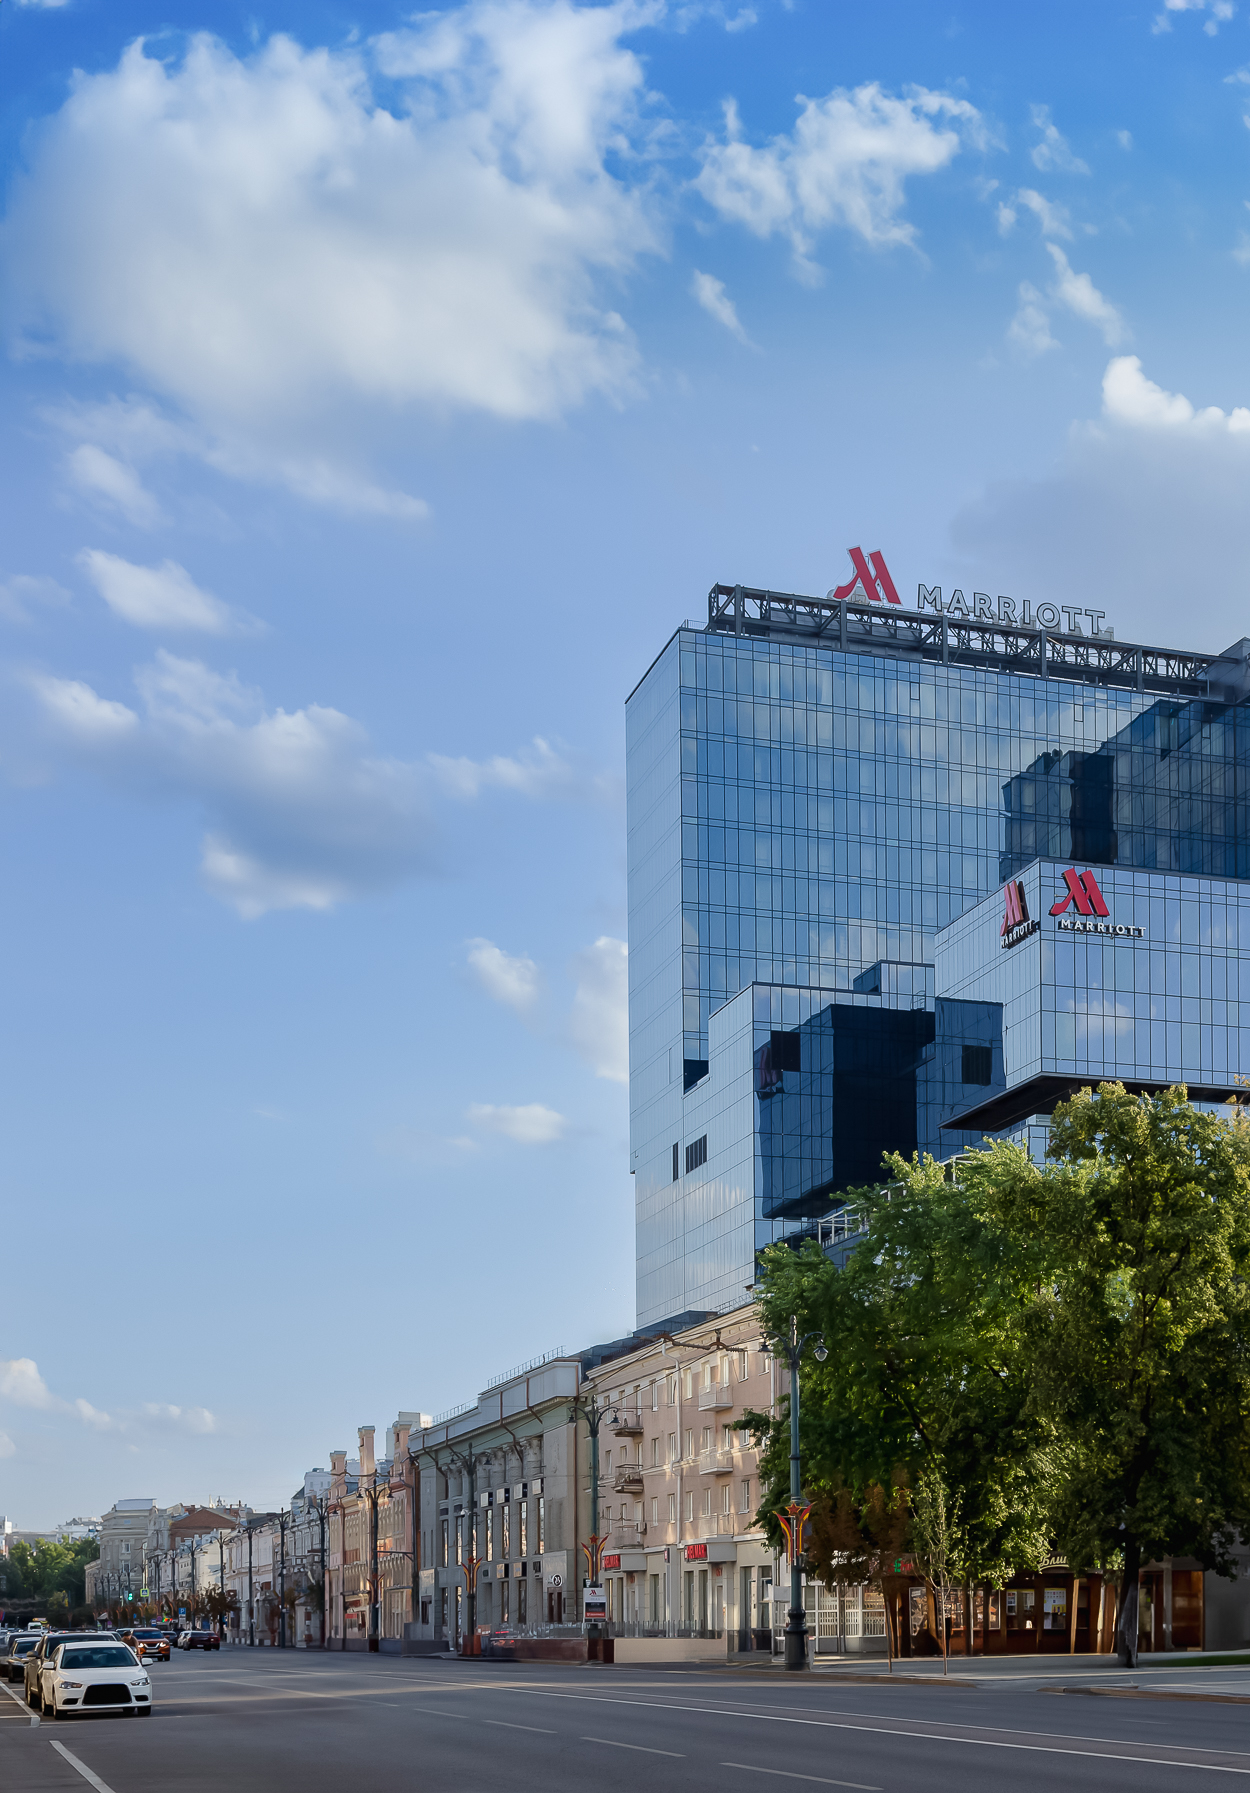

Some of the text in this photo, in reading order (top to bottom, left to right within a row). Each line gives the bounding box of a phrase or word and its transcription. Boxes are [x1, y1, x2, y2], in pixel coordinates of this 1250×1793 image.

[917, 583, 1106, 635] MARRIOTT
[1001, 920, 1032, 948] MARRIOTT
[1060, 918, 1147, 937] MARRIOTT
